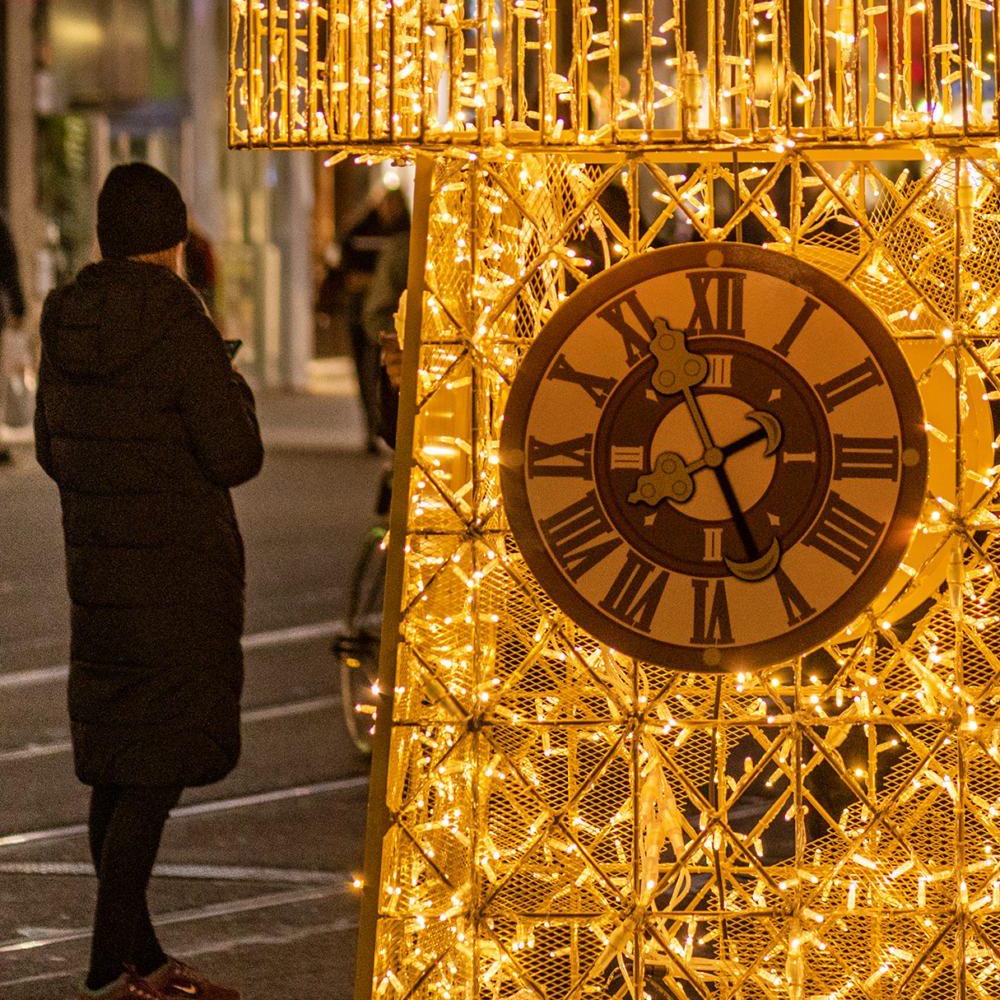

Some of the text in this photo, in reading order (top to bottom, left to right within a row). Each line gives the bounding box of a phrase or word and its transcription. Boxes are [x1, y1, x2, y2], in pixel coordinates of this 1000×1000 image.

[596, 290, 656, 369] XI
[686, 272, 747, 339] XII
[772, 296, 821, 358] I
[547, 354, 619, 409] X
[814, 355, 885, 414] II
[529, 434, 594, 481] IX
[833, 434, 898, 482] III
[538, 489, 625, 584] VIII
[703, 528, 723, 561] II
[801, 489, 886, 575] IIII
[598, 549, 670, 633] VII
[689, 579, 735, 644] VI
[773, 564, 817, 627] V
